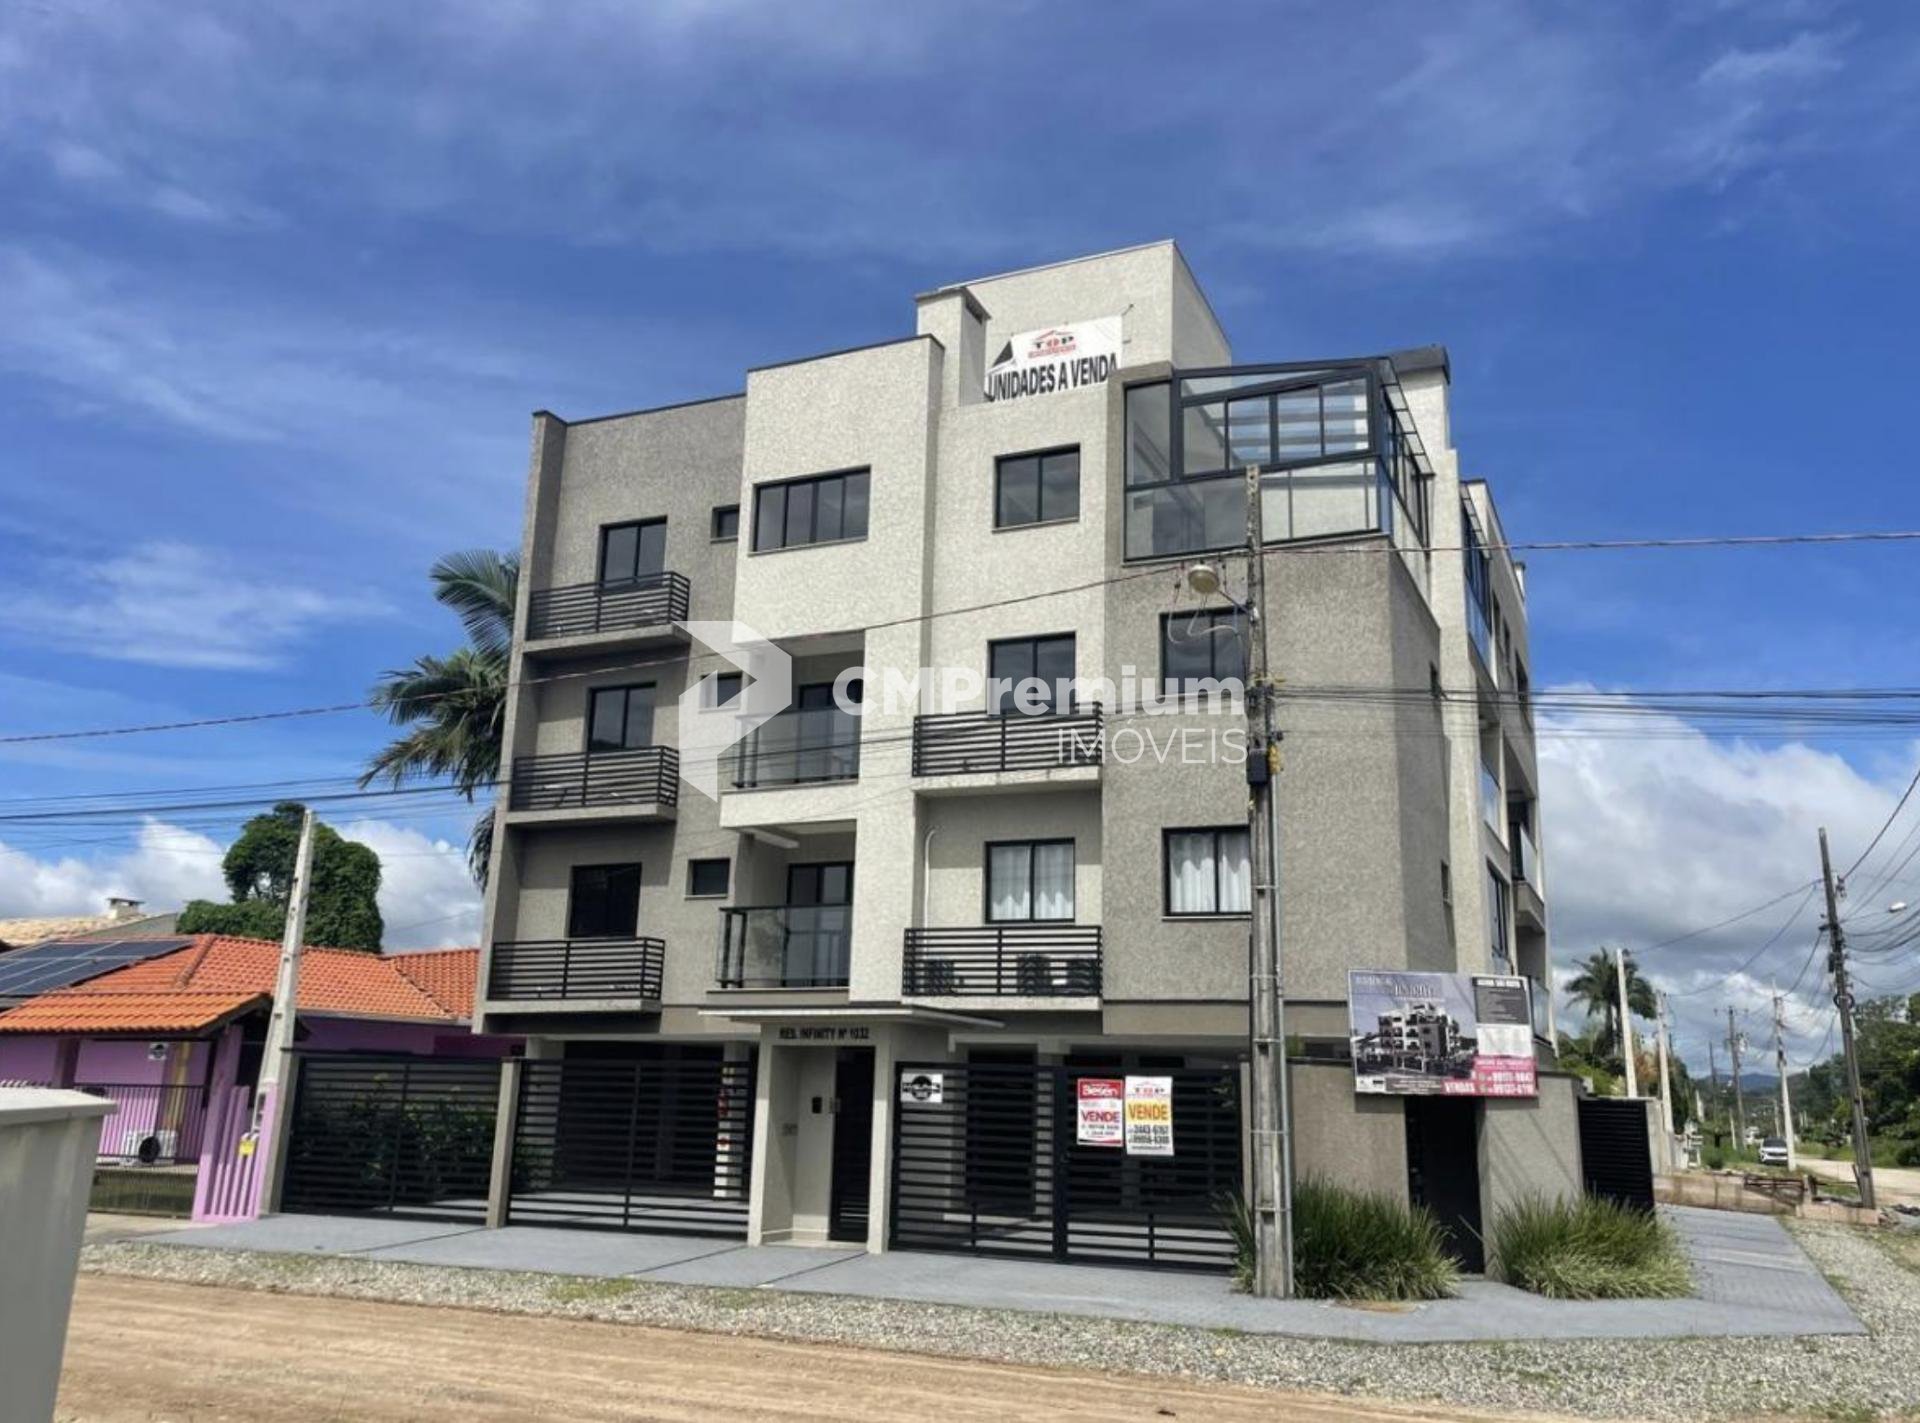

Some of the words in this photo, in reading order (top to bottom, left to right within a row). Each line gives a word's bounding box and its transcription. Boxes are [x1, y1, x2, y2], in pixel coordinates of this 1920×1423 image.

[984, 362, 1055, 402] UNIDADES
[1058, 361, 1068, 391] A
[1071, 352, 1118, 388] VENDA
[1081, 1110, 1120, 1123] VENDE
[1128, 1103, 1168, 1120] VENDE
